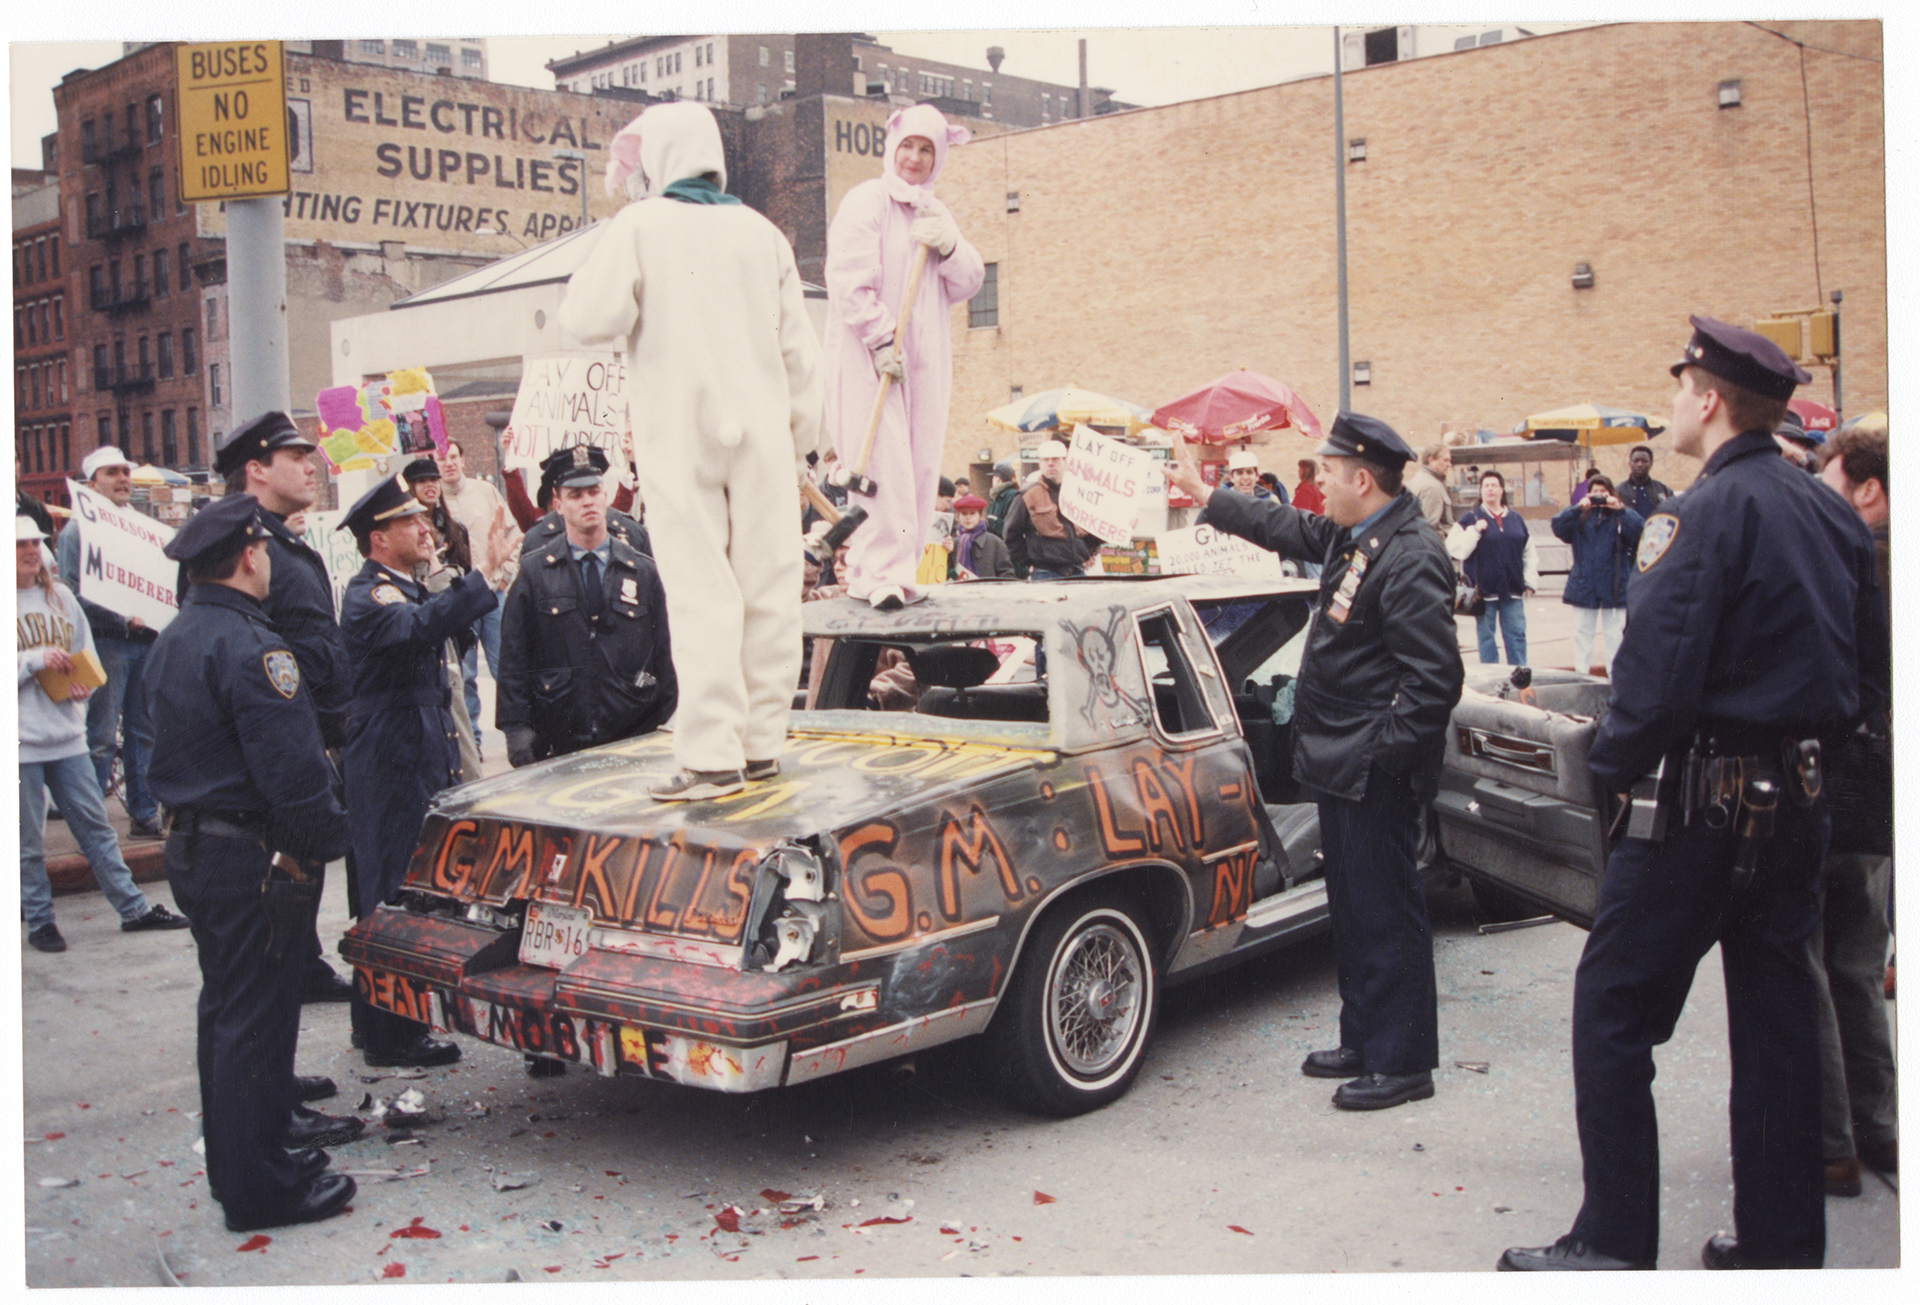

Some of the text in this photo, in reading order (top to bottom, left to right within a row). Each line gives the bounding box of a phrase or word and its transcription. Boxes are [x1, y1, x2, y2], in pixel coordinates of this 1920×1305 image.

[192, 44, 268, 80] BUSES
[214, 90, 248, 122] NO
[343, 87, 602, 151] ELECTRICAL
[196, 127, 271, 156] ENGINE
[202, 160, 268, 189] IDLING
[375, 142, 579, 196] SUPPLIES
[524, 360, 627, 393] LAY OFF
[1076, 434, 1136, 467] LAY OFF
[1066, 456, 1137, 498] ANIMALS
[1077, 486, 1105, 506] NOT
[1061, 496, 1129, 543] WORKERS
[1203, 541, 1249, 558] ANIMALS
[574, 832, 759, 942] KILLS
[523, 918, 554, 951] RBR
